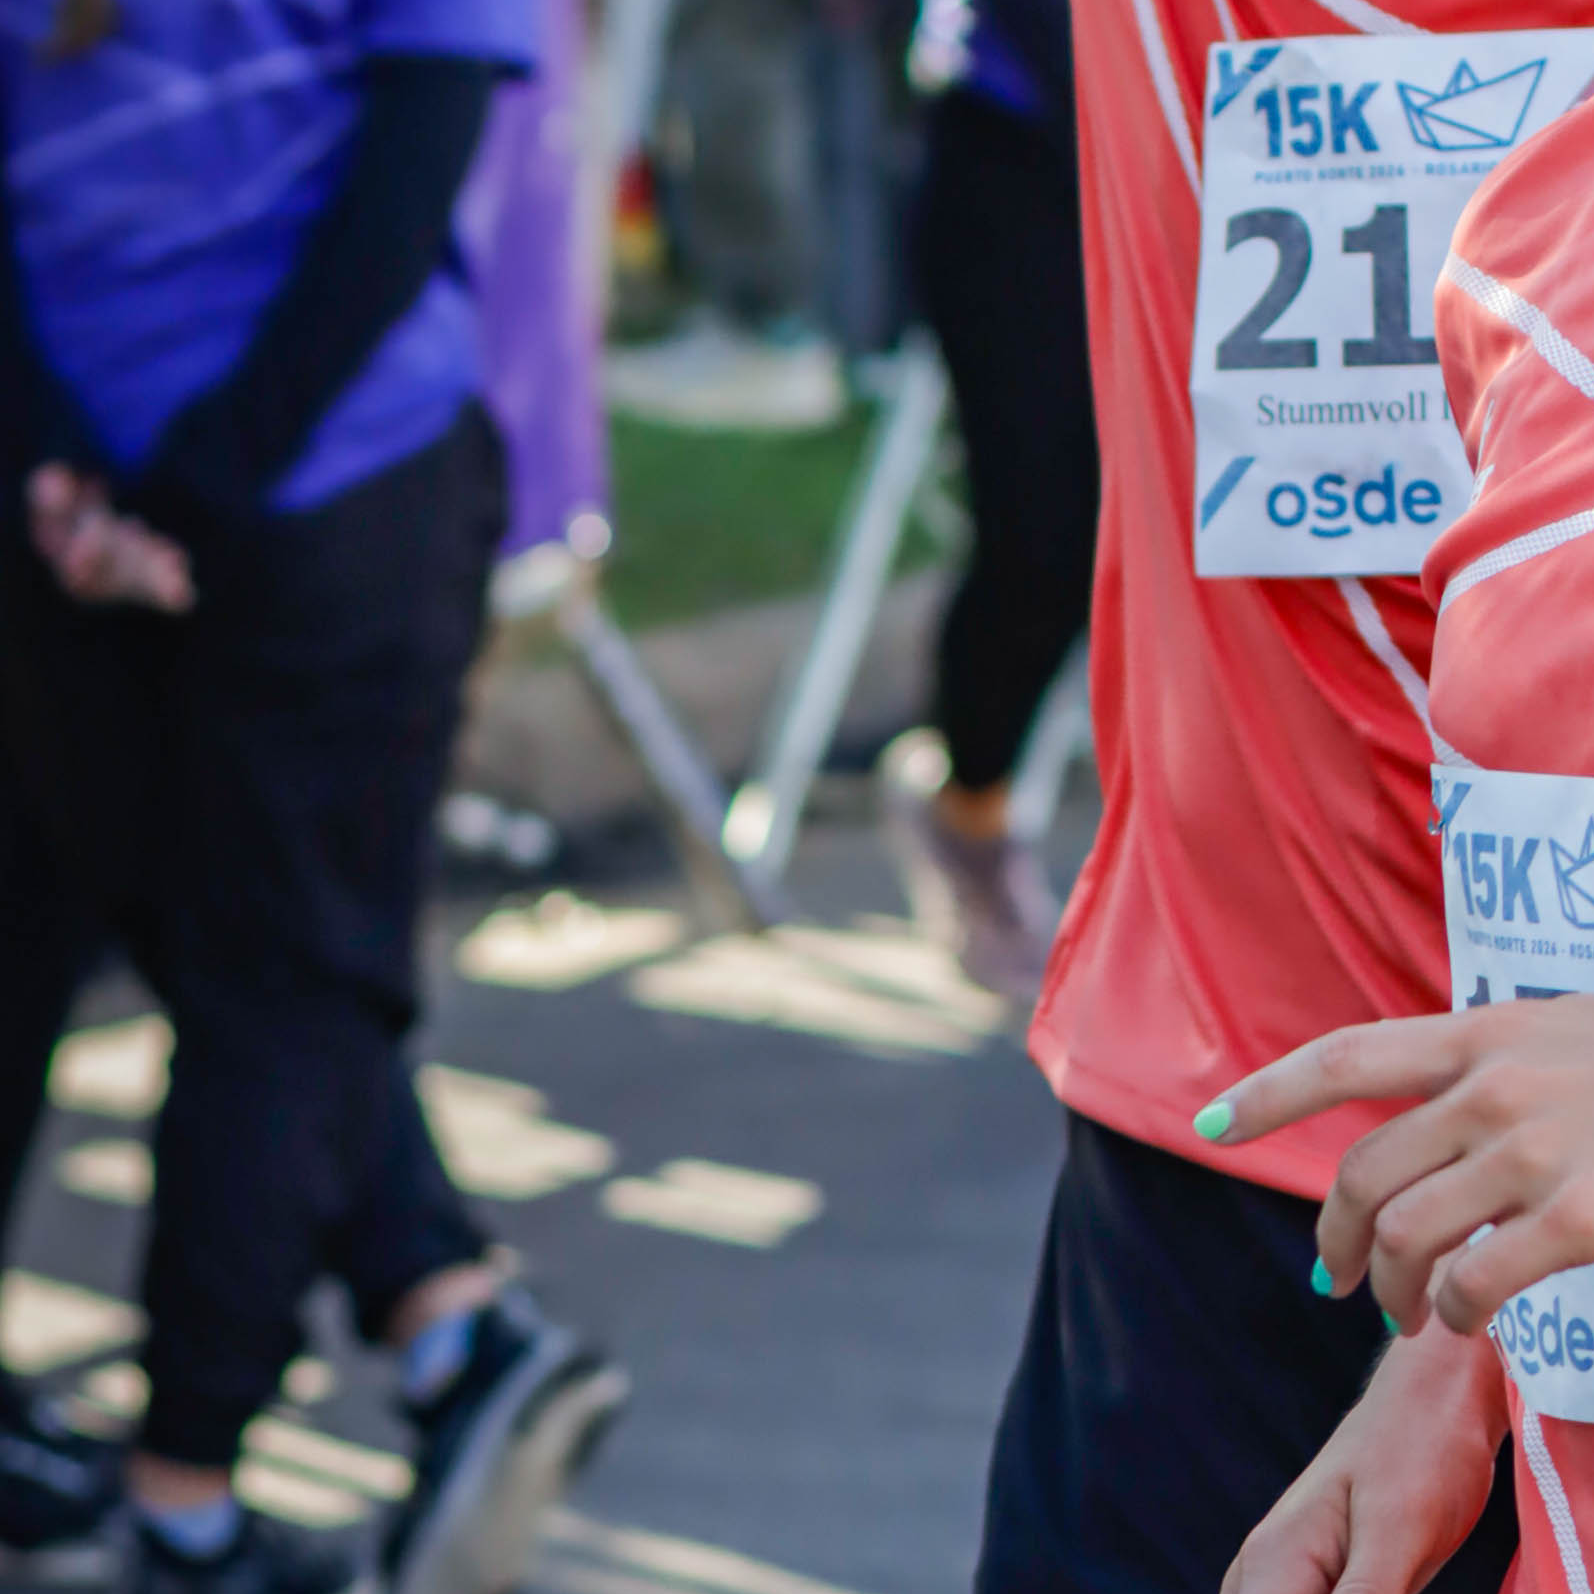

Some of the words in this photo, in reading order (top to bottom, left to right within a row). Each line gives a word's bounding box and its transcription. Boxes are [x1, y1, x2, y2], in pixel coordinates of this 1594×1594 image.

[1253, 80, 1382, 159] 15K
[1257, 389, 1427, 426] Stummvoll
[1266, 462, 1442, 539] osde
[1453, 832, 1541, 924] 15K
